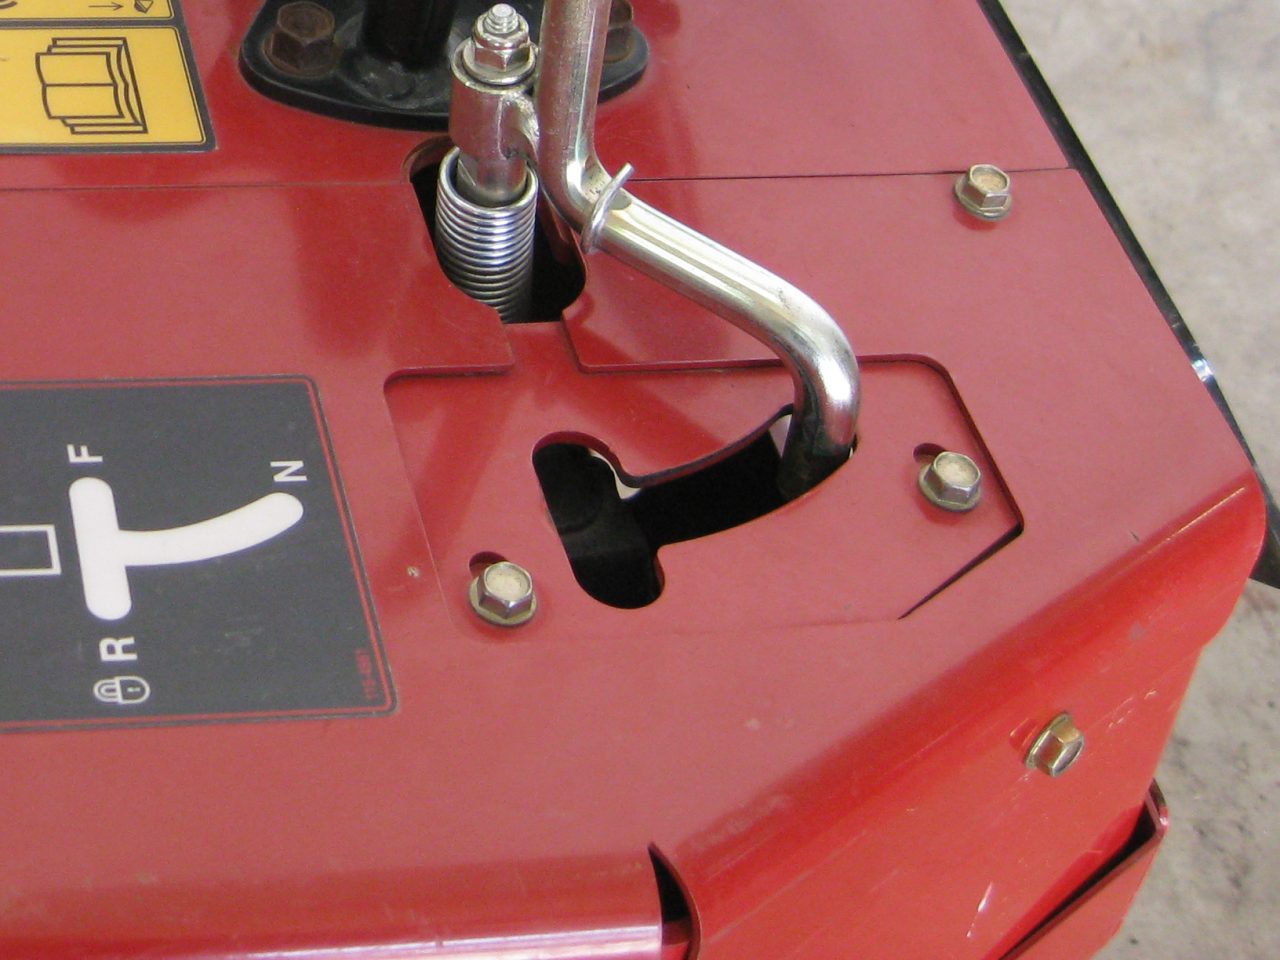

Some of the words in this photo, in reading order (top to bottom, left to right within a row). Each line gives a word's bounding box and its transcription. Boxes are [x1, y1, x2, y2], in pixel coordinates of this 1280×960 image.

[67, 443, 103, 464] F
[269, 459, 307, 483] N
[99, 636, 138, 661] R
